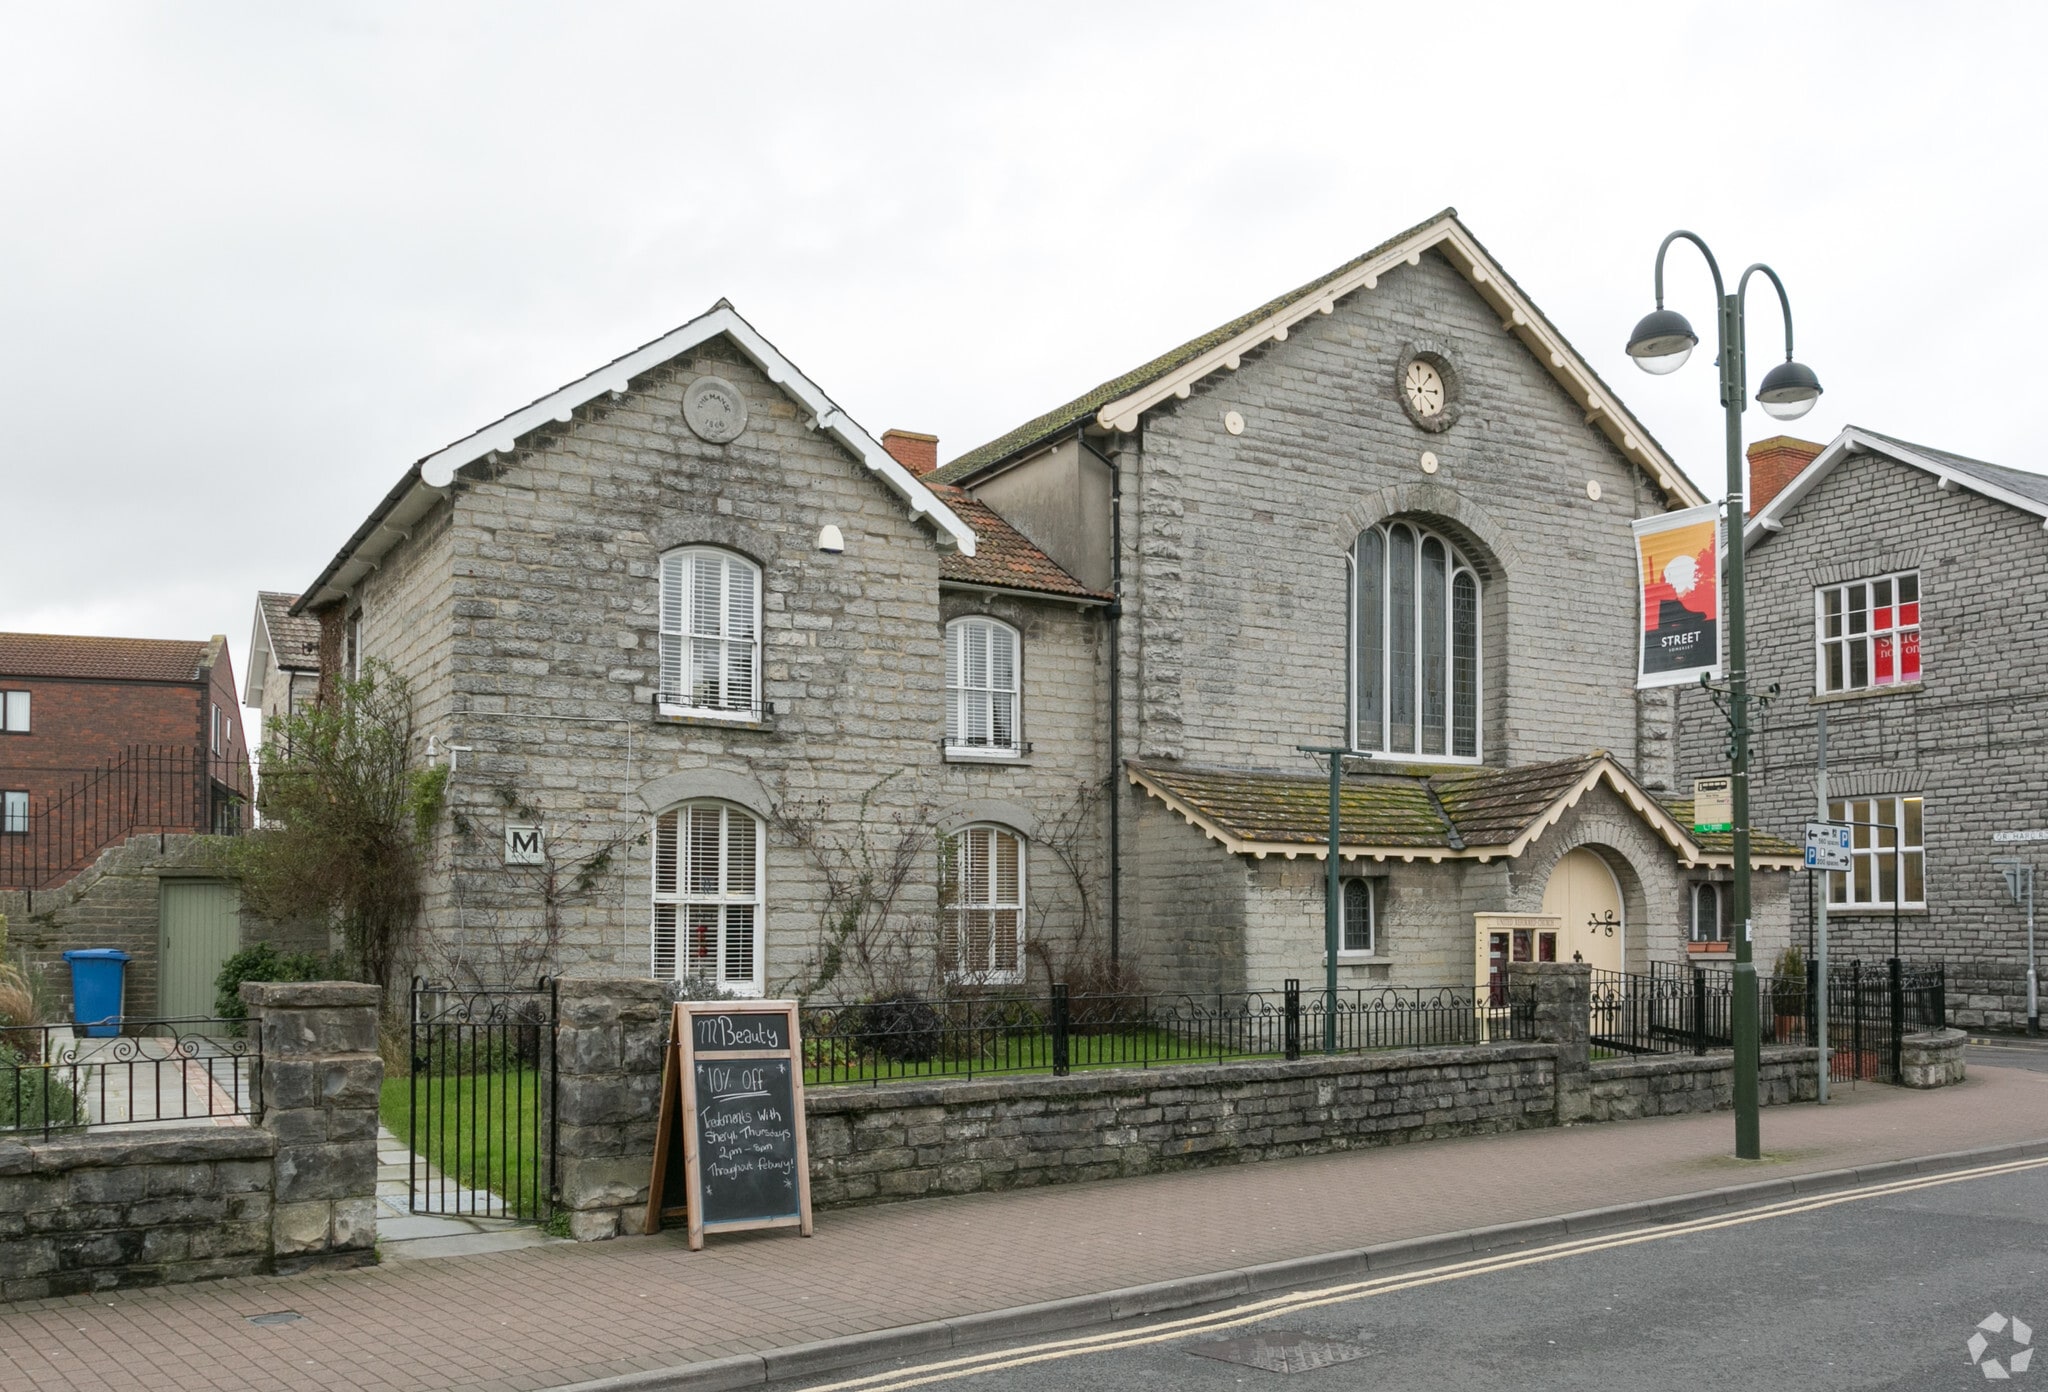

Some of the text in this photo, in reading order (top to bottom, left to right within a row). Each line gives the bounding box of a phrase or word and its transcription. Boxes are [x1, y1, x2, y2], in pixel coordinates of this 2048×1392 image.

[1661, 631, 1701, 647] STREET
[512, 831, 538, 853] M
[707, 1067, 733, 1093] 10%
[739, 1125, 791, 1142] Thursdays
[719, 1146, 743, 1161] 2pm
